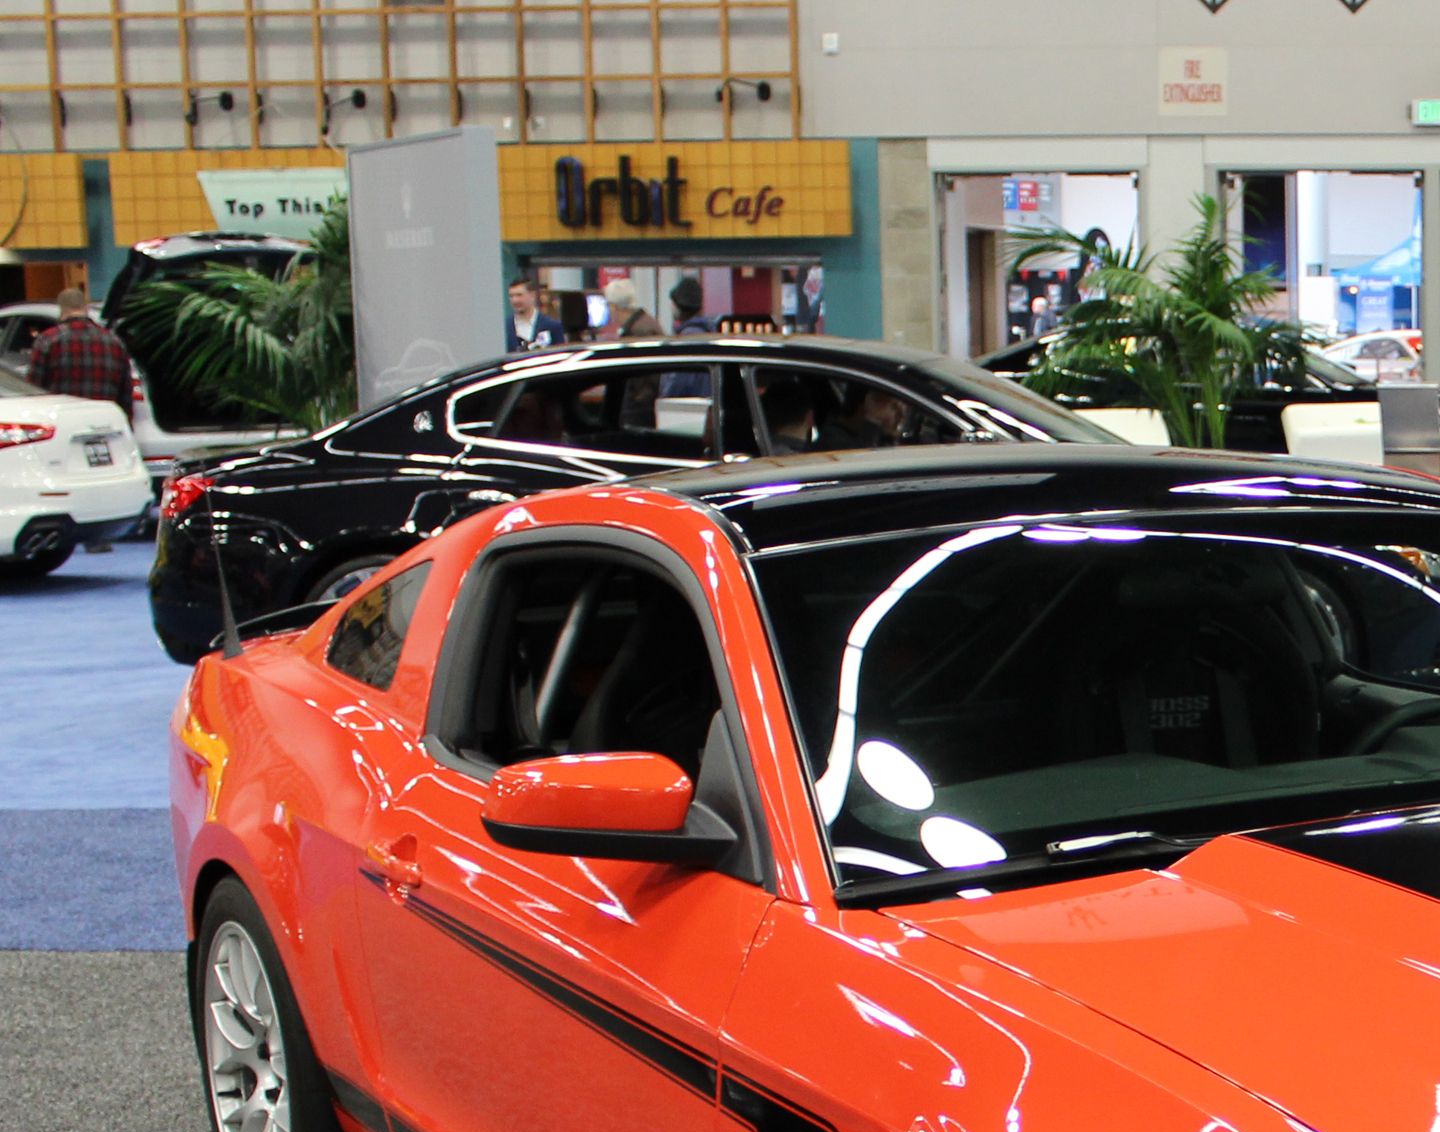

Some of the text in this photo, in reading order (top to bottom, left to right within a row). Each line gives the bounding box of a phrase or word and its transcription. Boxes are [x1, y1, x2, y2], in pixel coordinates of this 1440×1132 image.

[226, 200, 263, 219] Top
[555, 155, 784, 227] Orbit Cafe
